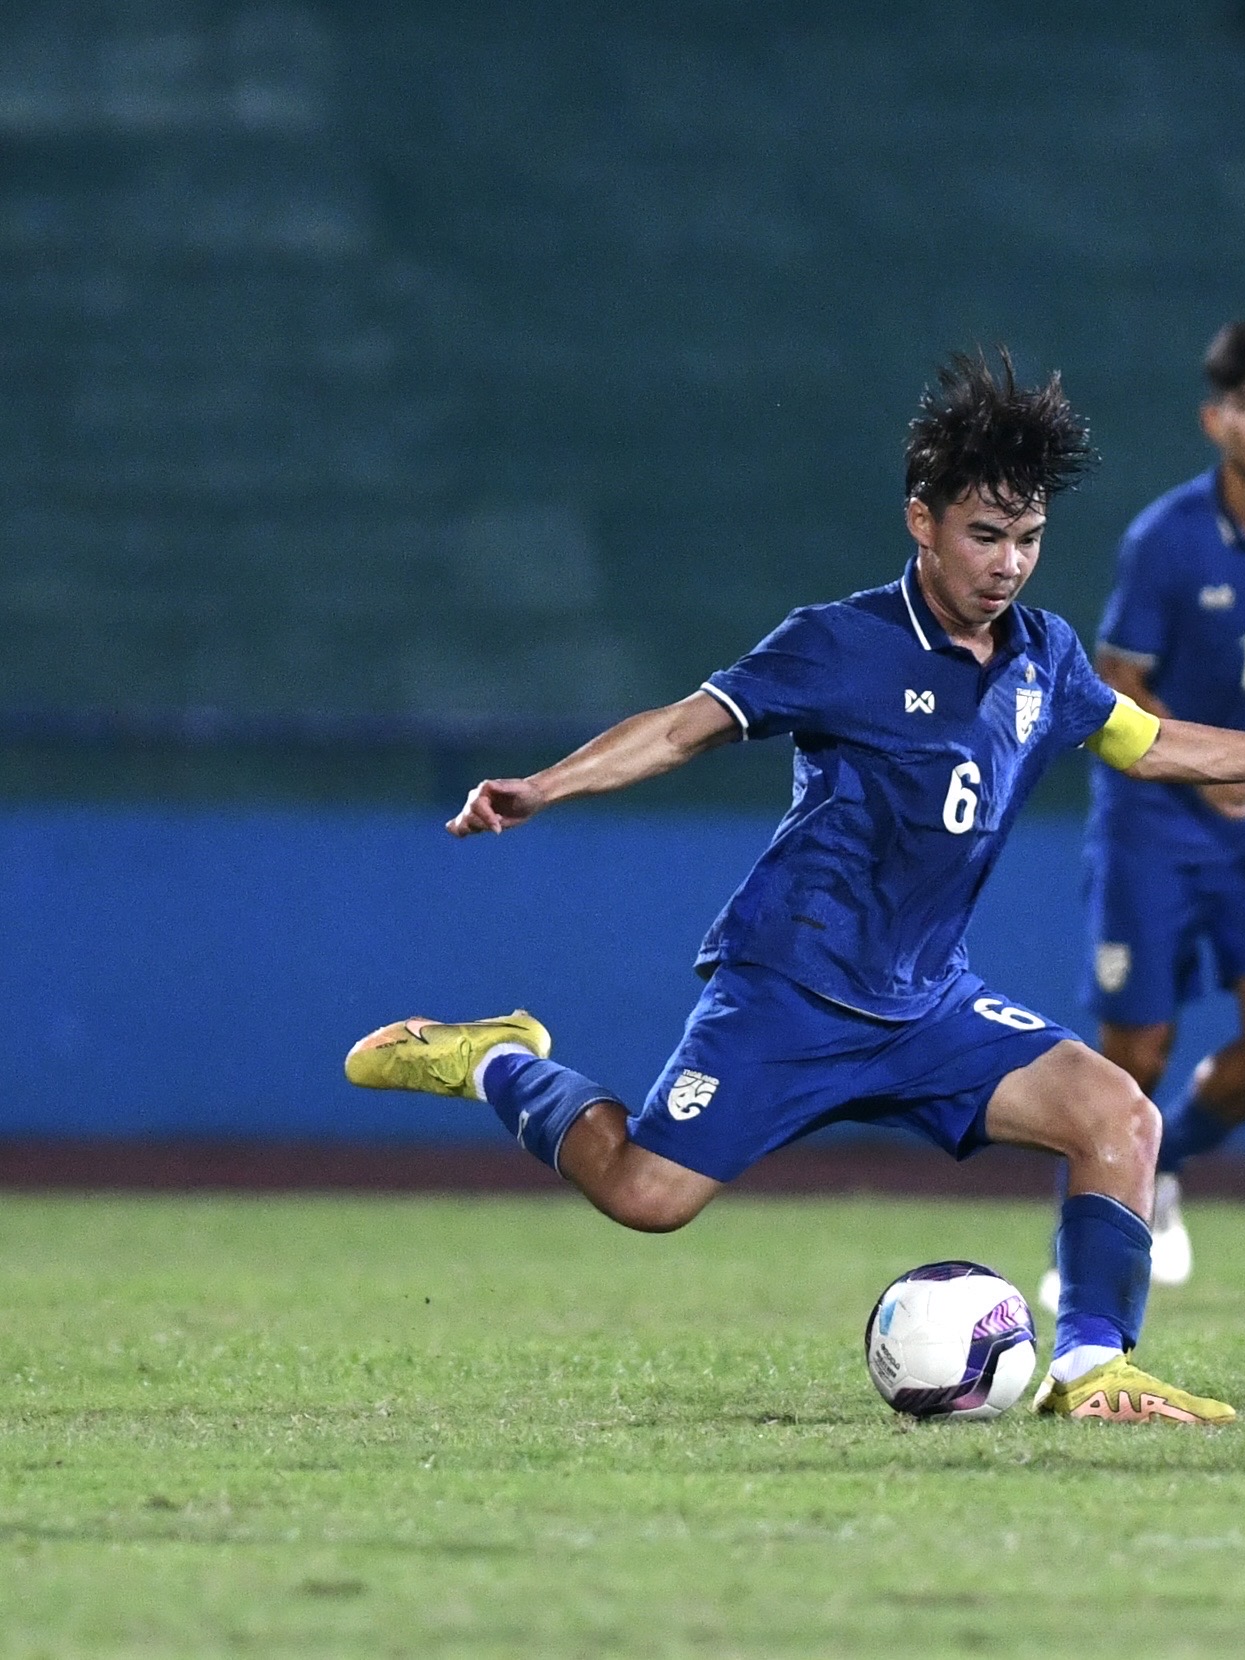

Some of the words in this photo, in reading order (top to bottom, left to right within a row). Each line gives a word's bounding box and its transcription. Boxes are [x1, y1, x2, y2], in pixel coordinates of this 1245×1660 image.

[942, 760, 981, 834] 6
[972, 996, 1047, 1031] 6
[1070, 1390, 1206, 1423] AIR
